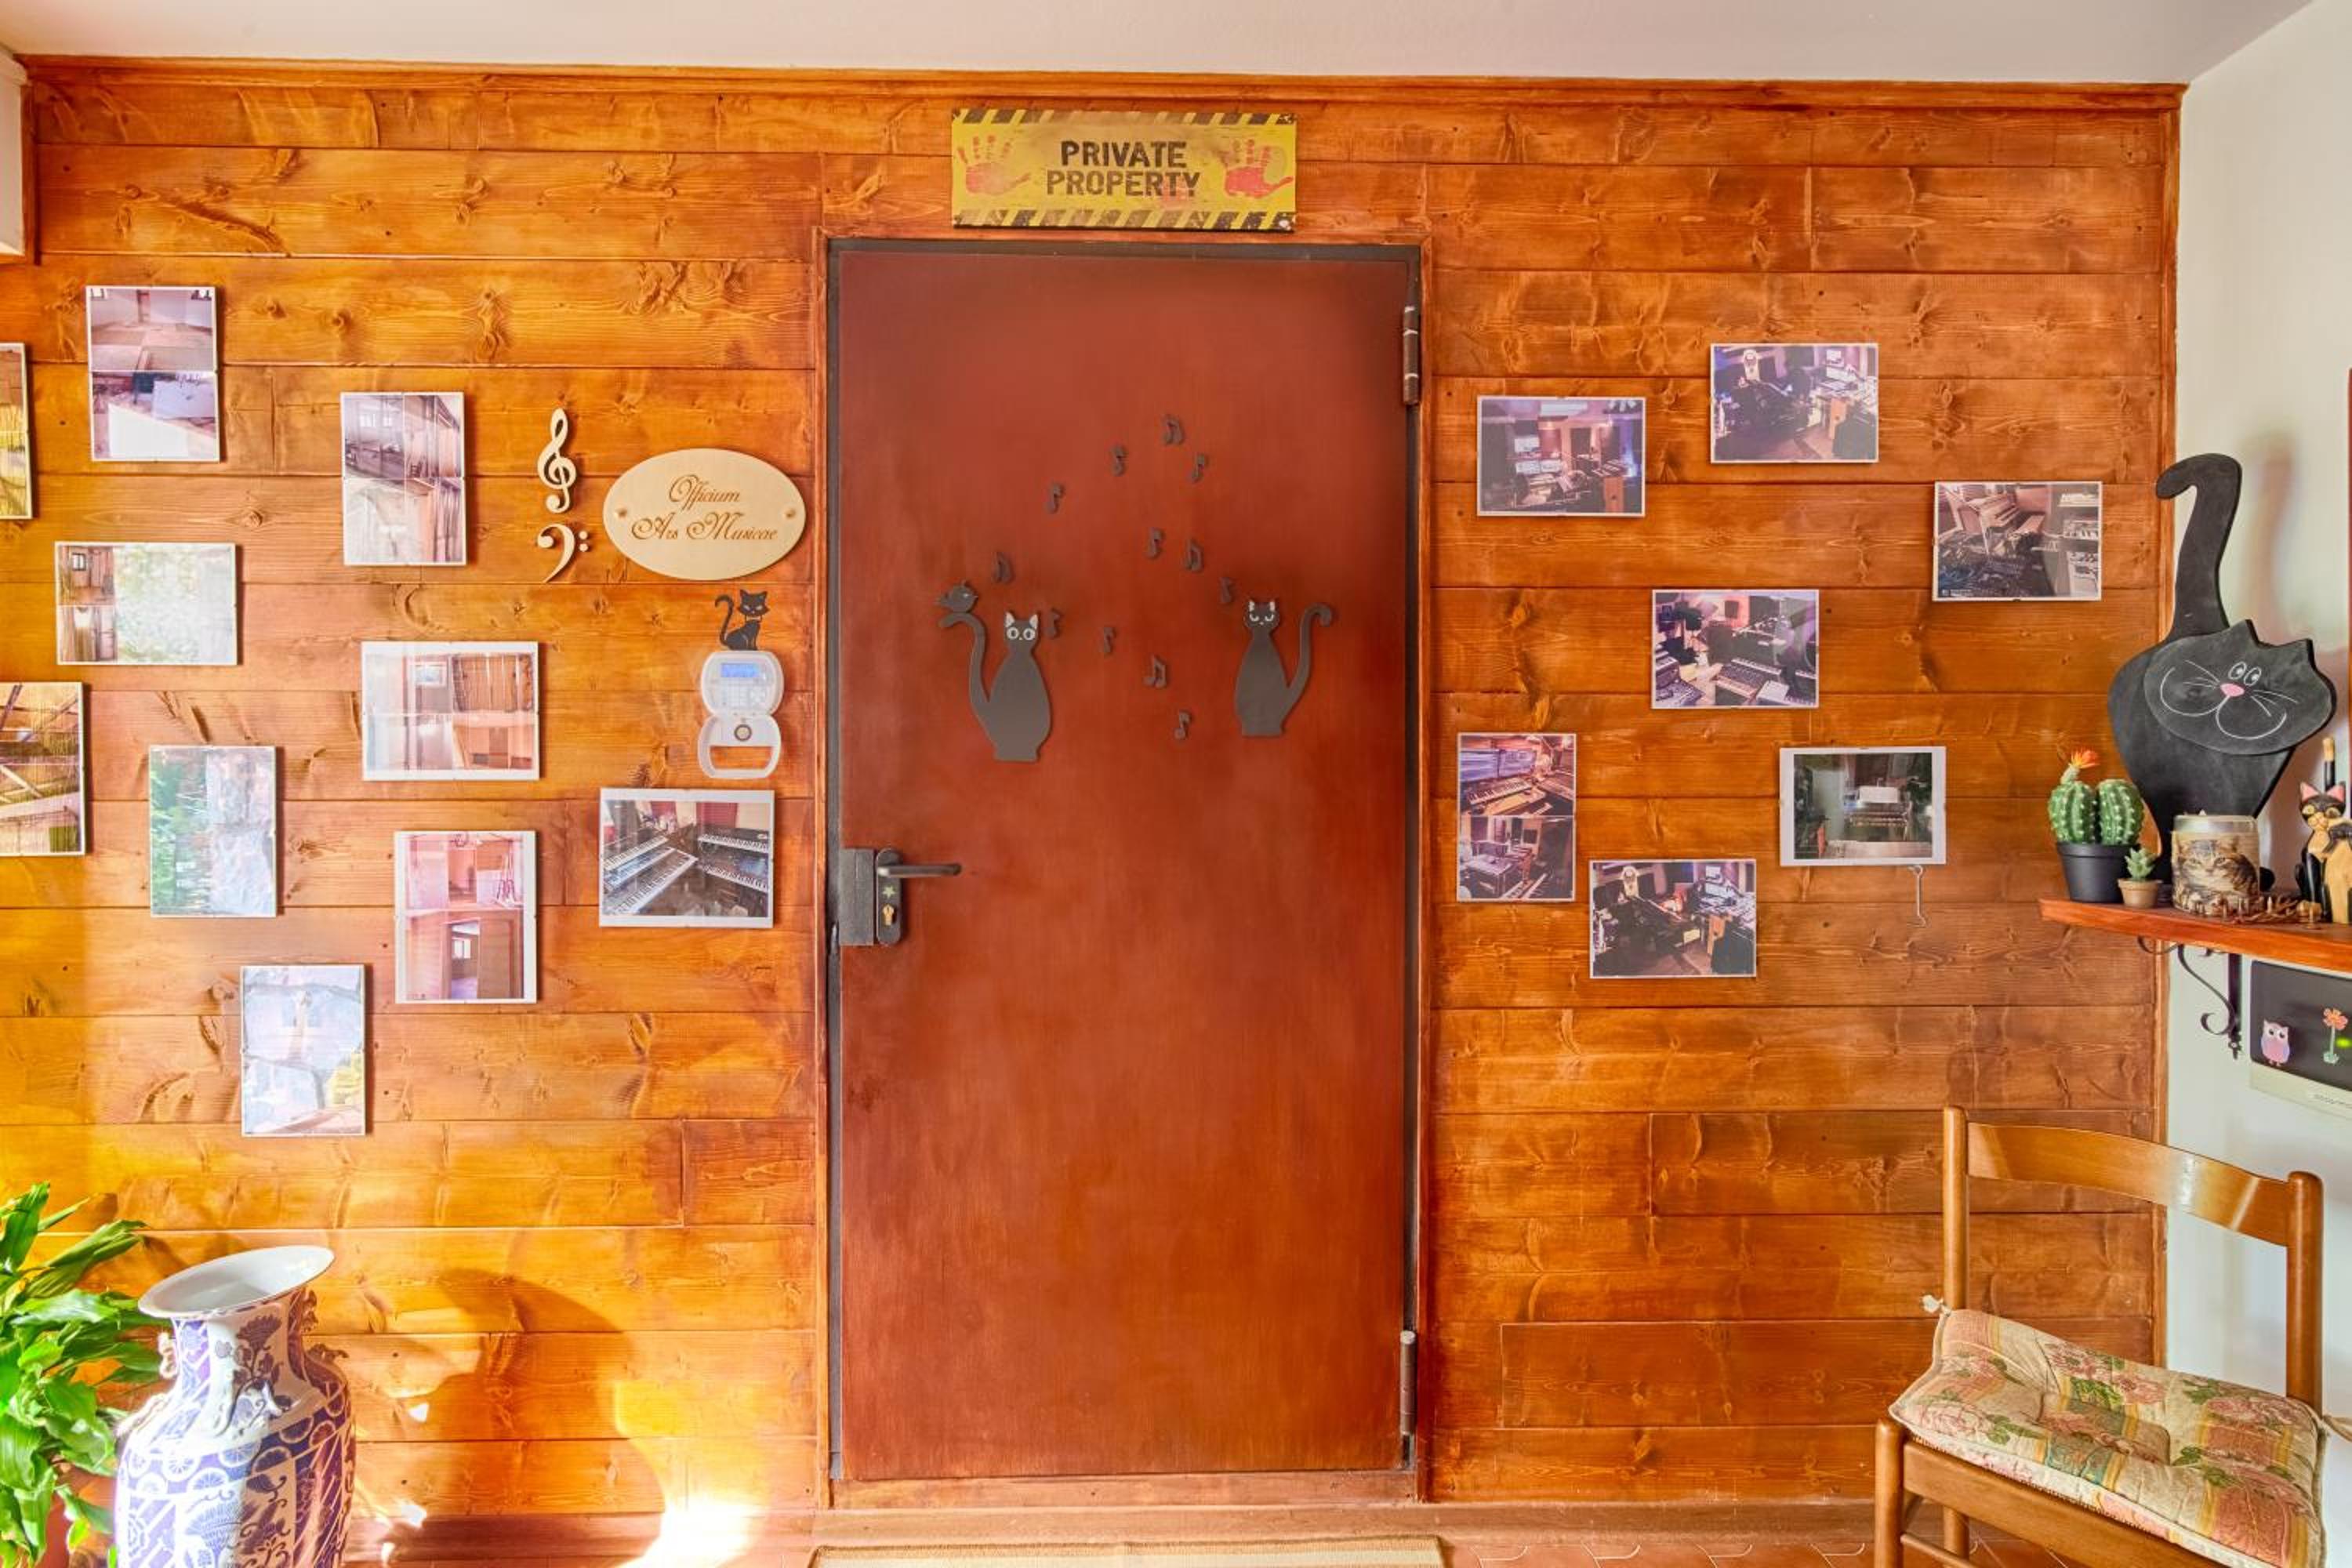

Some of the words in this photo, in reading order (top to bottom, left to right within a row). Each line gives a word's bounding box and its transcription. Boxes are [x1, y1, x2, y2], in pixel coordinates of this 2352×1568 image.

[1061, 140, 1187, 168] PRIVATE
[1047, 169, 1201, 197] PROPERTY
[669, 474, 741, 512] Officium
[631, 511, 679, 540] Ars
